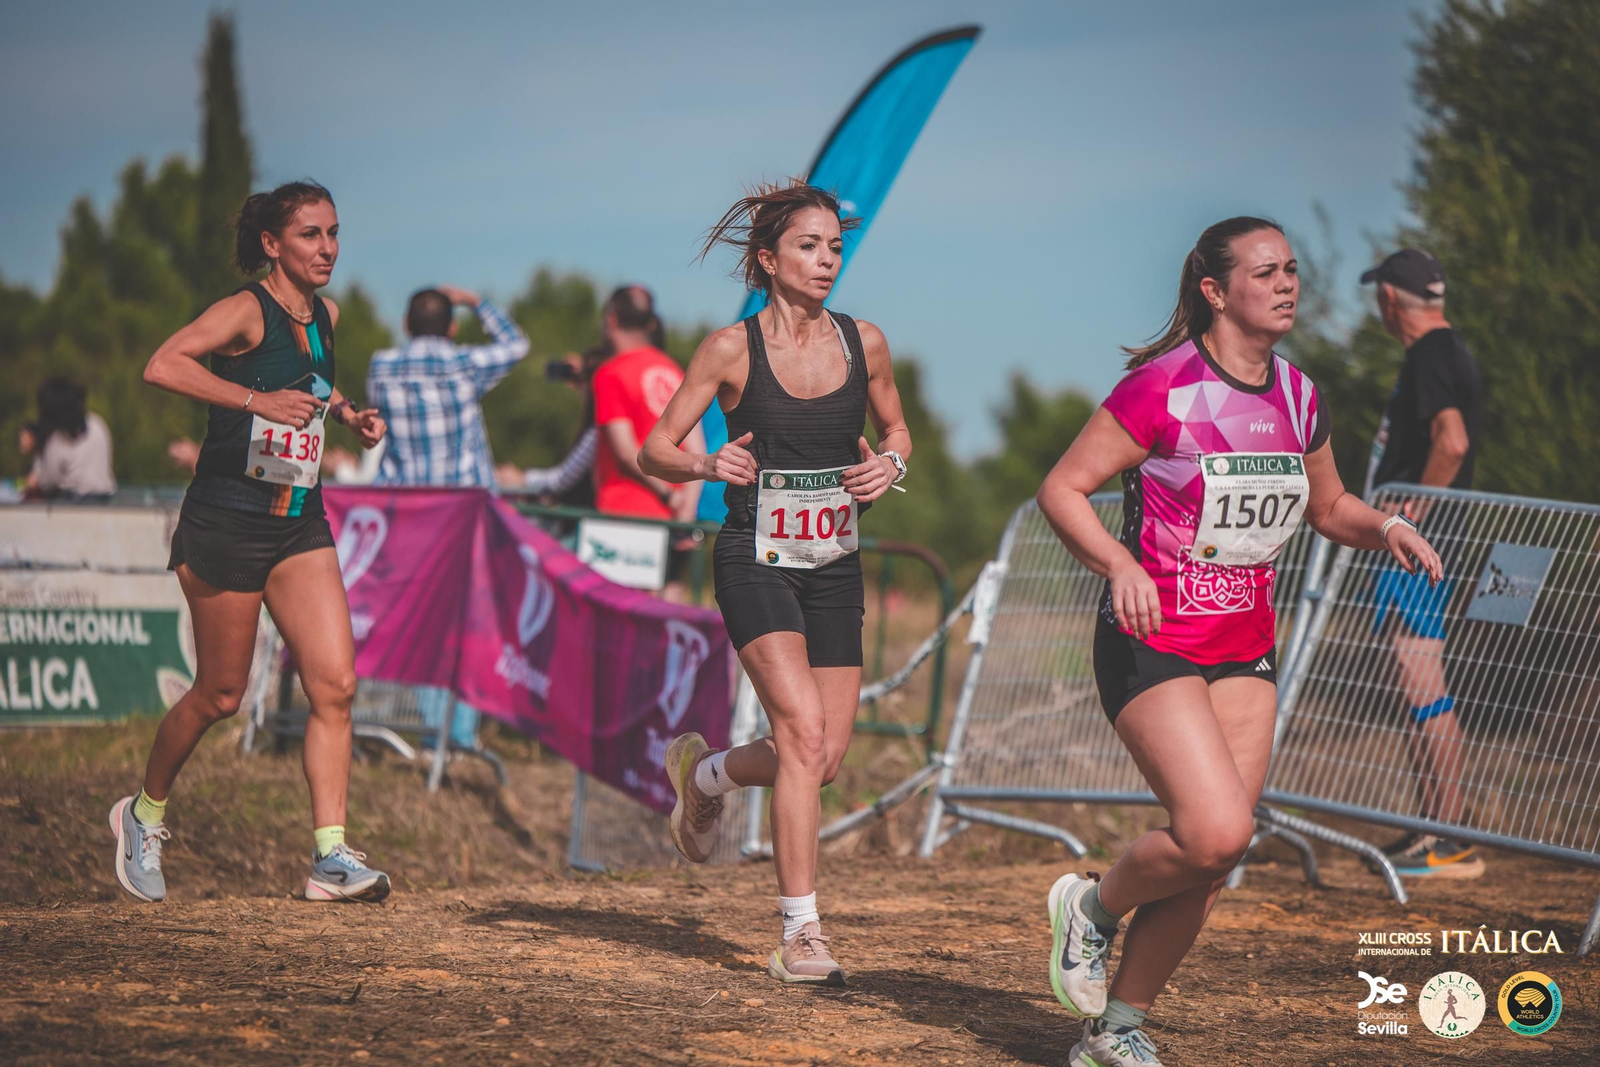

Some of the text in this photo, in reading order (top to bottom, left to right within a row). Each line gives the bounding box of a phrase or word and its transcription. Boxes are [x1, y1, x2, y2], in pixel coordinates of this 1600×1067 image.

[259, 428, 320, 463] 1138
[793, 474, 838, 487] ITÁLICA
[1236, 457, 1284, 472] ITÁLICA
[769, 505, 852, 540] 1102
[1213, 493, 1301, 529] 1507
